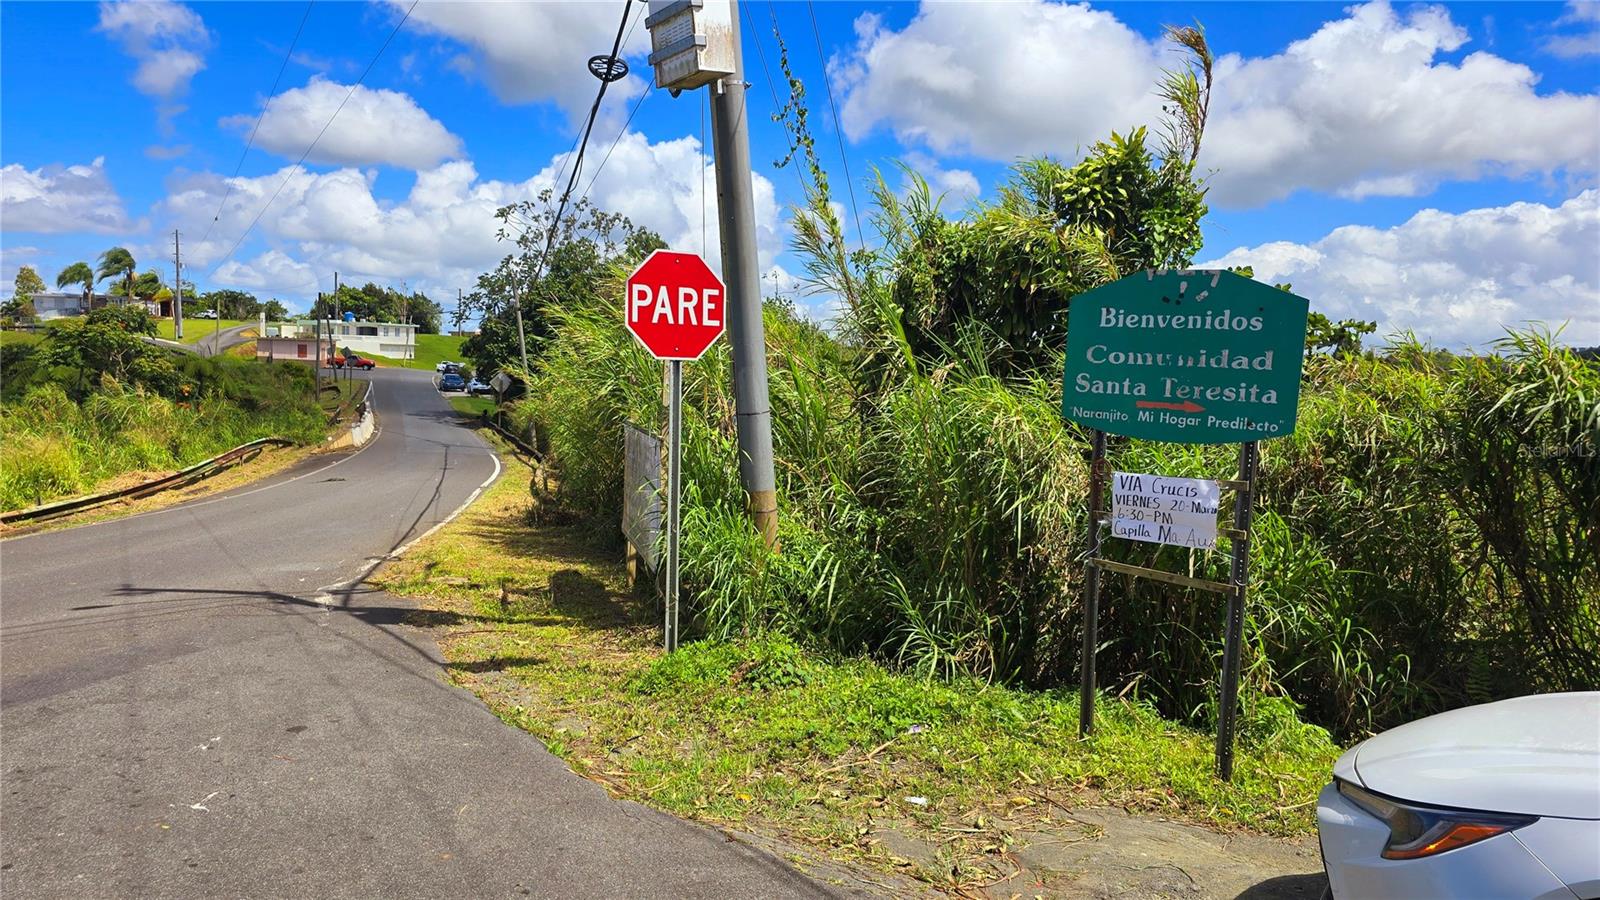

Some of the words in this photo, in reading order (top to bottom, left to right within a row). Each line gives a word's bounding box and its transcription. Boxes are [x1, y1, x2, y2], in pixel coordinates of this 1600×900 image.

[632, 284, 720, 326] PARE
[1099, 307, 1263, 331] Bienvenidos
[1075, 373, 1146, 396] Santa
[1161, 377, 1278, 404] Teresita
[1137, 410, 1154, 422] Mi
[1160, 413, 1201, 429] Hogar
[1120, 475, 1142, 493] VIA
[1115, 494, 1161, 510] VIERNES
[1114, 520, 1152, 538] Capilla
